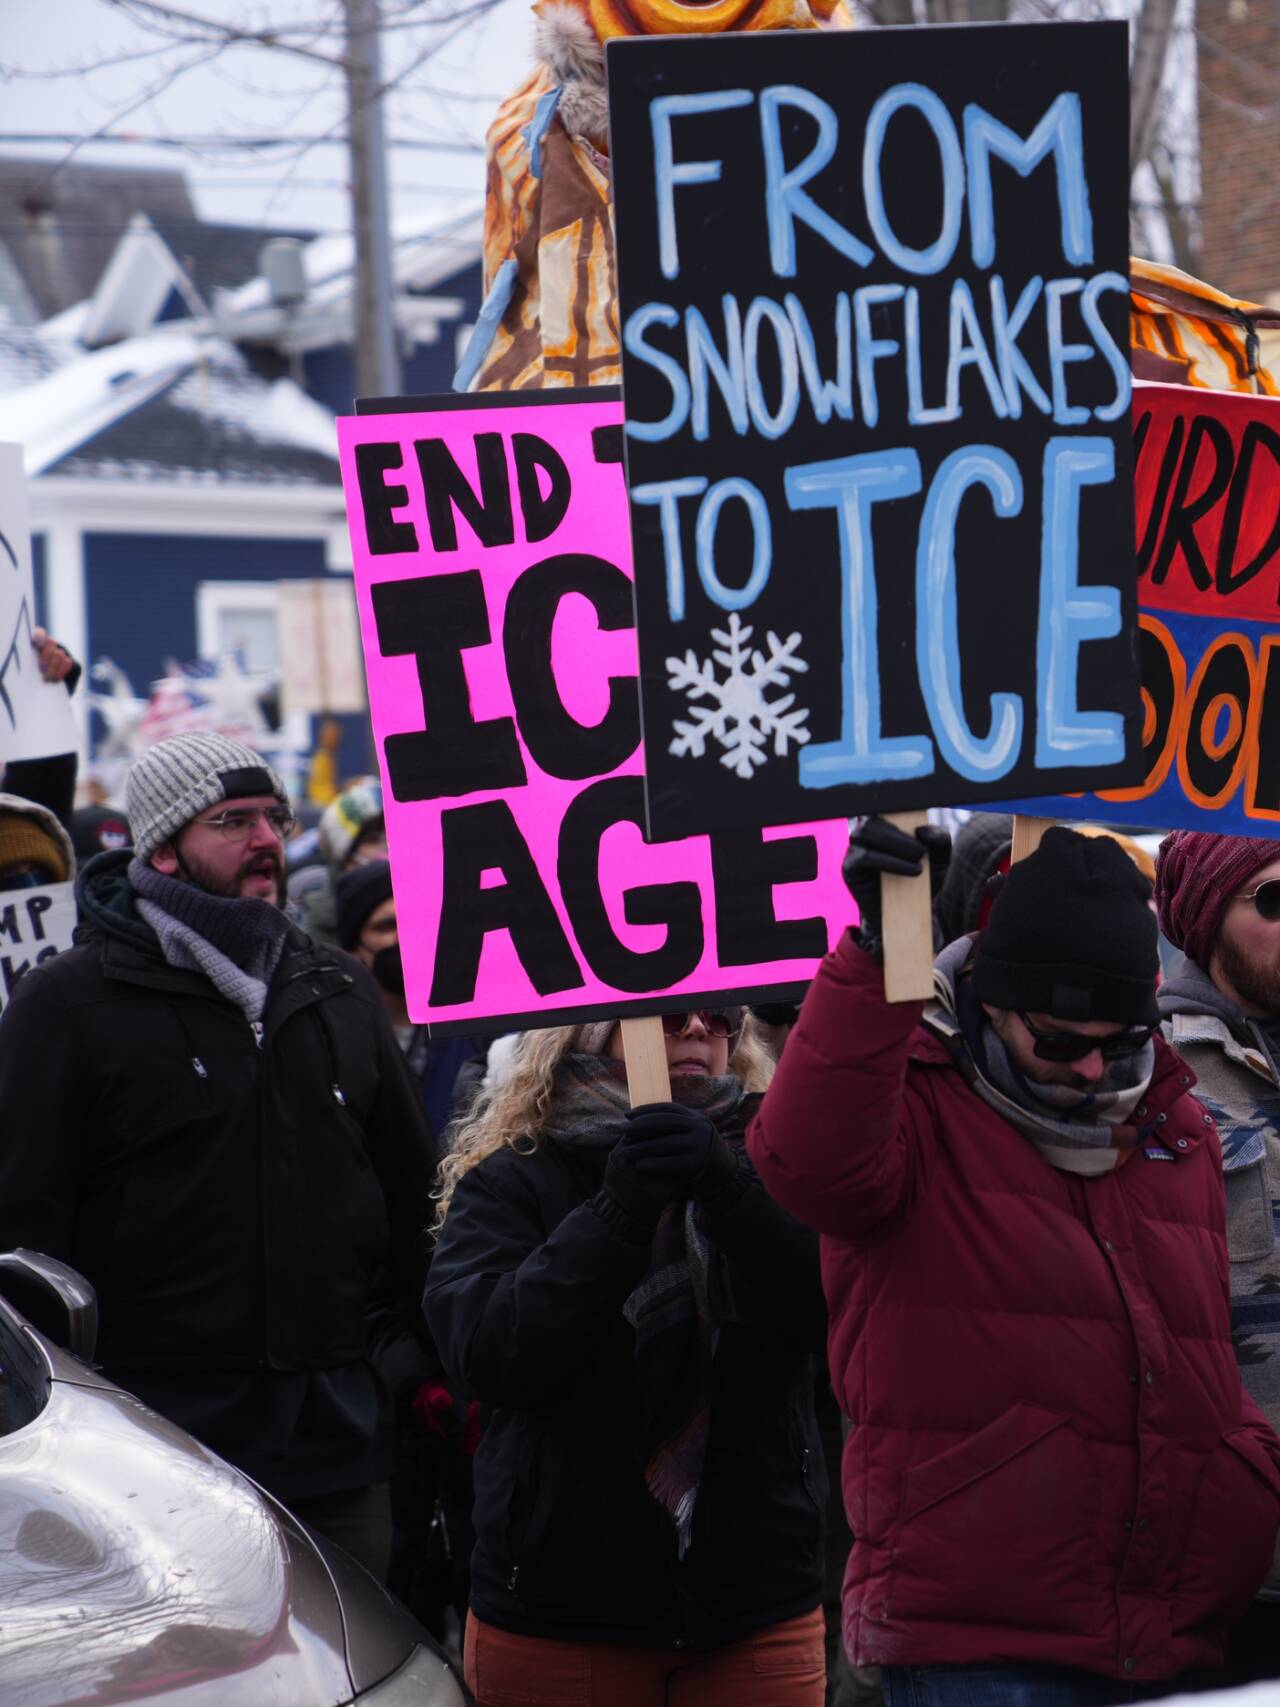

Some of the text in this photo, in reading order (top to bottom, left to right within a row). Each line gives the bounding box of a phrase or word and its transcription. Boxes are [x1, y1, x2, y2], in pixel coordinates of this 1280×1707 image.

[649, 82, 1095, 279] FROM
[623, 271, 1134, 442] SNOWFLAKES
[355, 432, 572, 555] END
[632, 436, 1127, 789] TO ICE
[428, 776, 829, 1007] AGE
